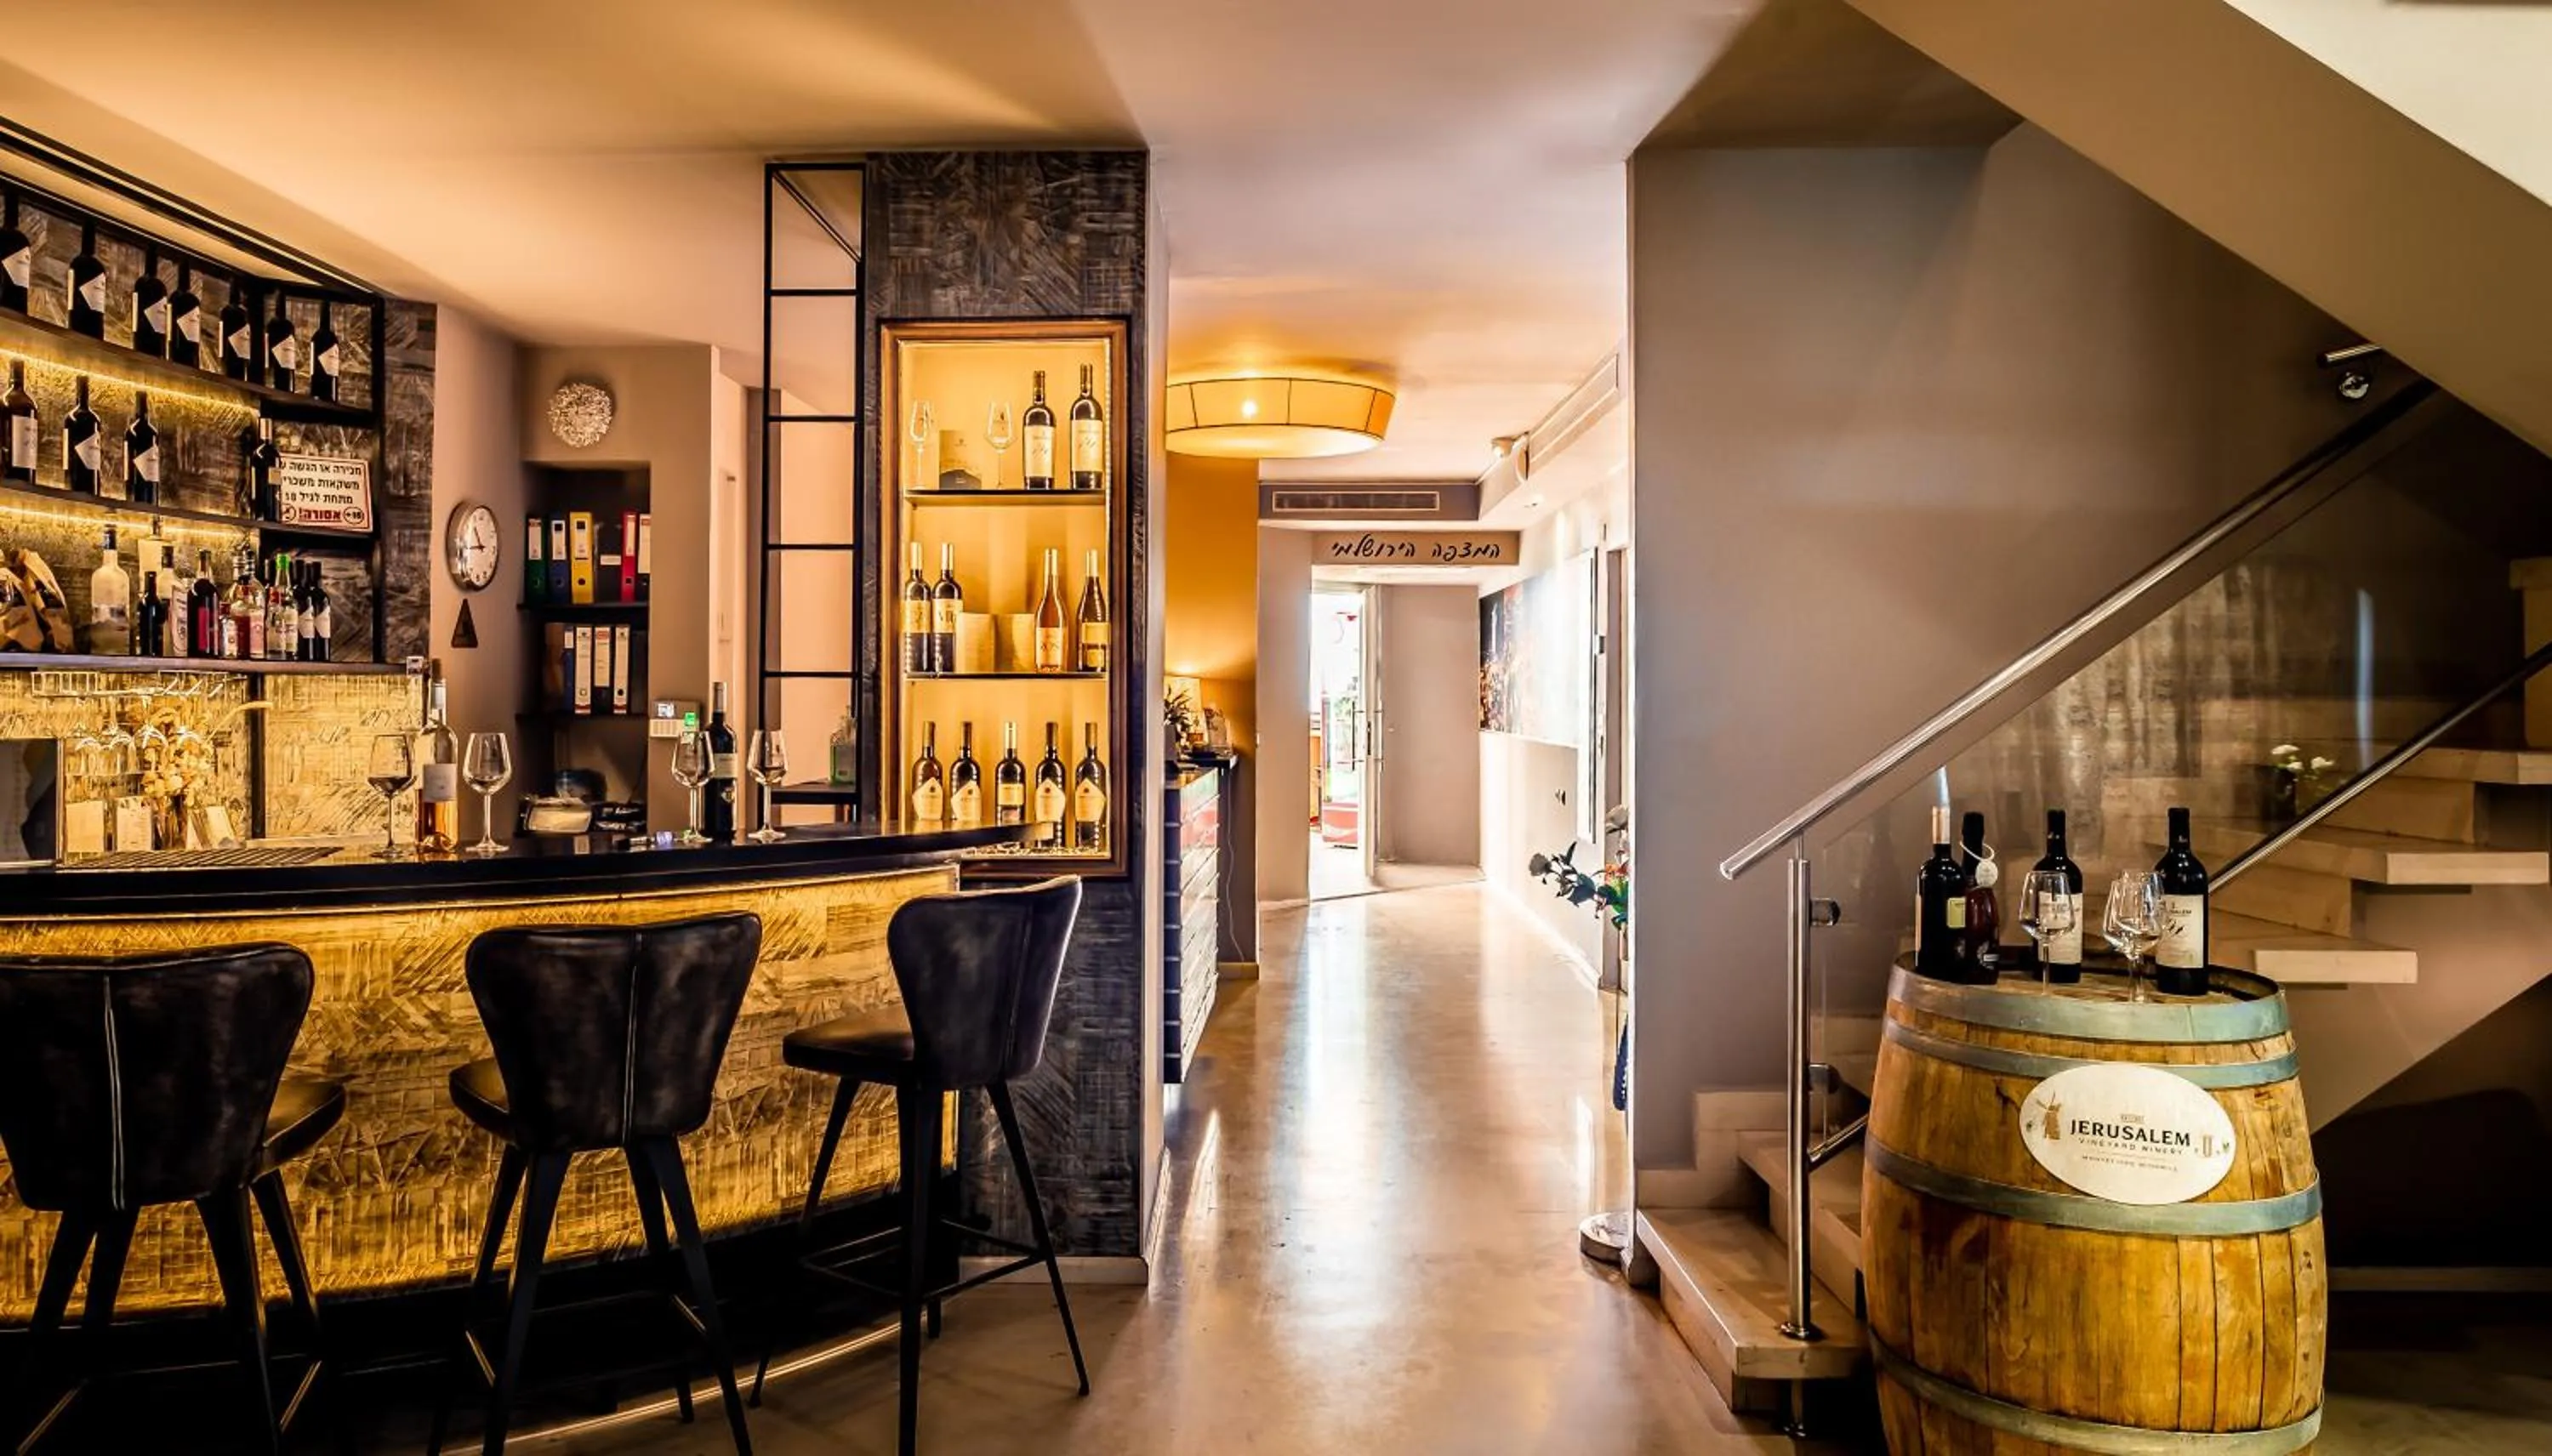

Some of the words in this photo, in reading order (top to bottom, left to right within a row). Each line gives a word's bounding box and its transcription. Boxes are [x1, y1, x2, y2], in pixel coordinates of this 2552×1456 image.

[289, 462, 317, 472] הגשה
[319, 464, 331, 473] או
[282, 475, 315, 487] משכרי
[317, 477, 360, 490] משקאות
[299, 492, 321, 503] לגיל
[322, 494, 353, 503] מתחת
[299, 507, 341, 520] אסורה!
[1331, 533, 1416, 558] הירושלמי
[1431, 542, 1501, 562] המצפה
[2070, 1118, 2191, 1146] JERUSALEM
[2078, 1137, 2136, 1151] VINEYARD
[2141, 1146, 2184, 1155] WINERY
